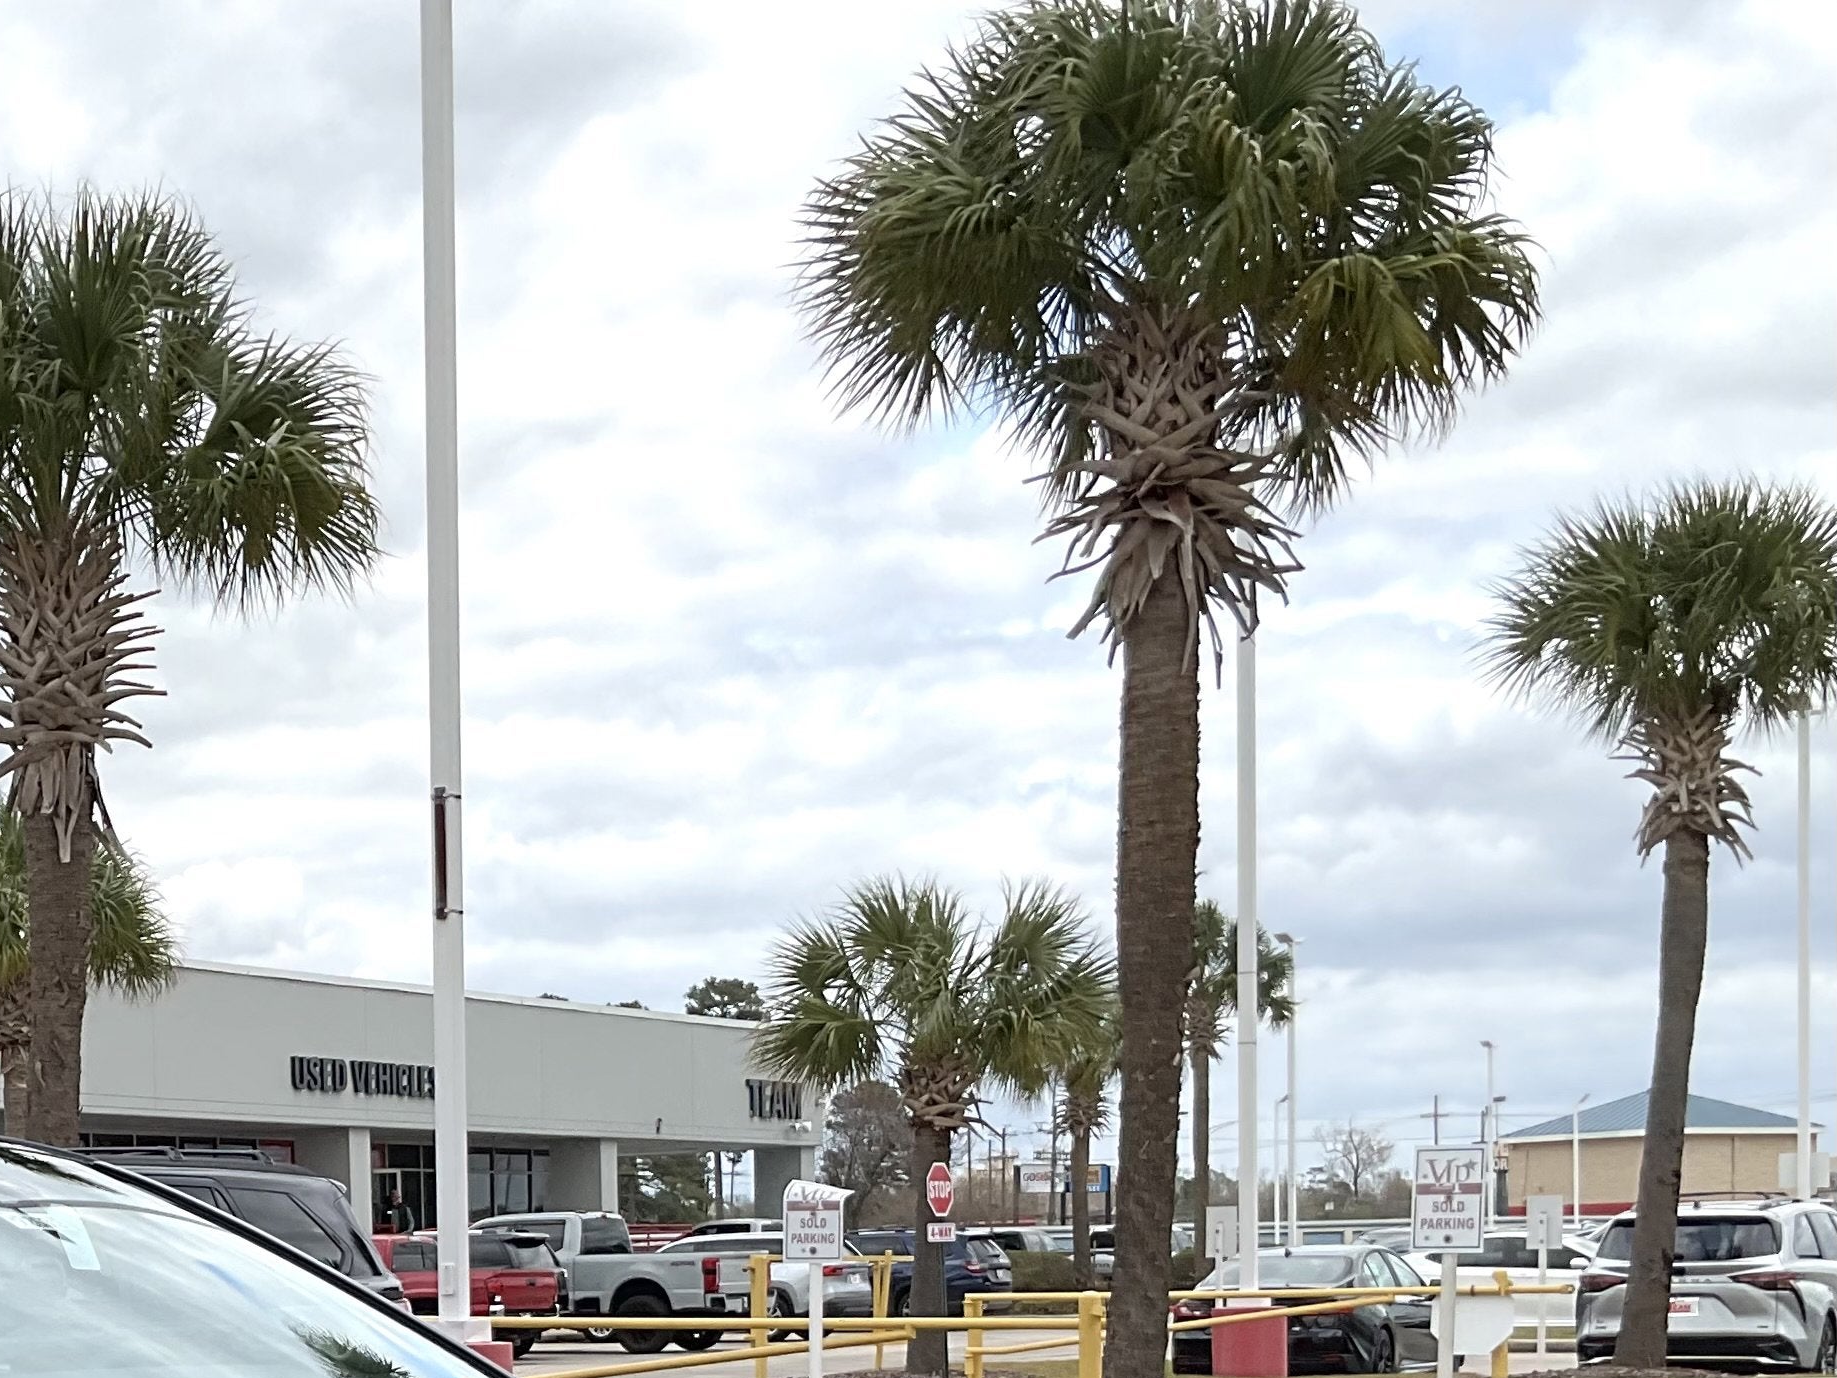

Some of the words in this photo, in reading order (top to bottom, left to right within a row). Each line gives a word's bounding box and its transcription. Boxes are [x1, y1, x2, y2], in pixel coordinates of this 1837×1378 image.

[290, 1056, 348, 1092] USED
[745, 1079, 803, 1120] TEAM
[929, 1180, 951, 1199] STOP
[1431, 1201, 1465, 1213] SOLD
[799, 1217, 827, 1229] SOLD
[1420, 1217, 1475, 1230] PARKING
[790, 1232, 836, 1244] PARKING
[931, 1226, 952, 1239] 4-WAY
